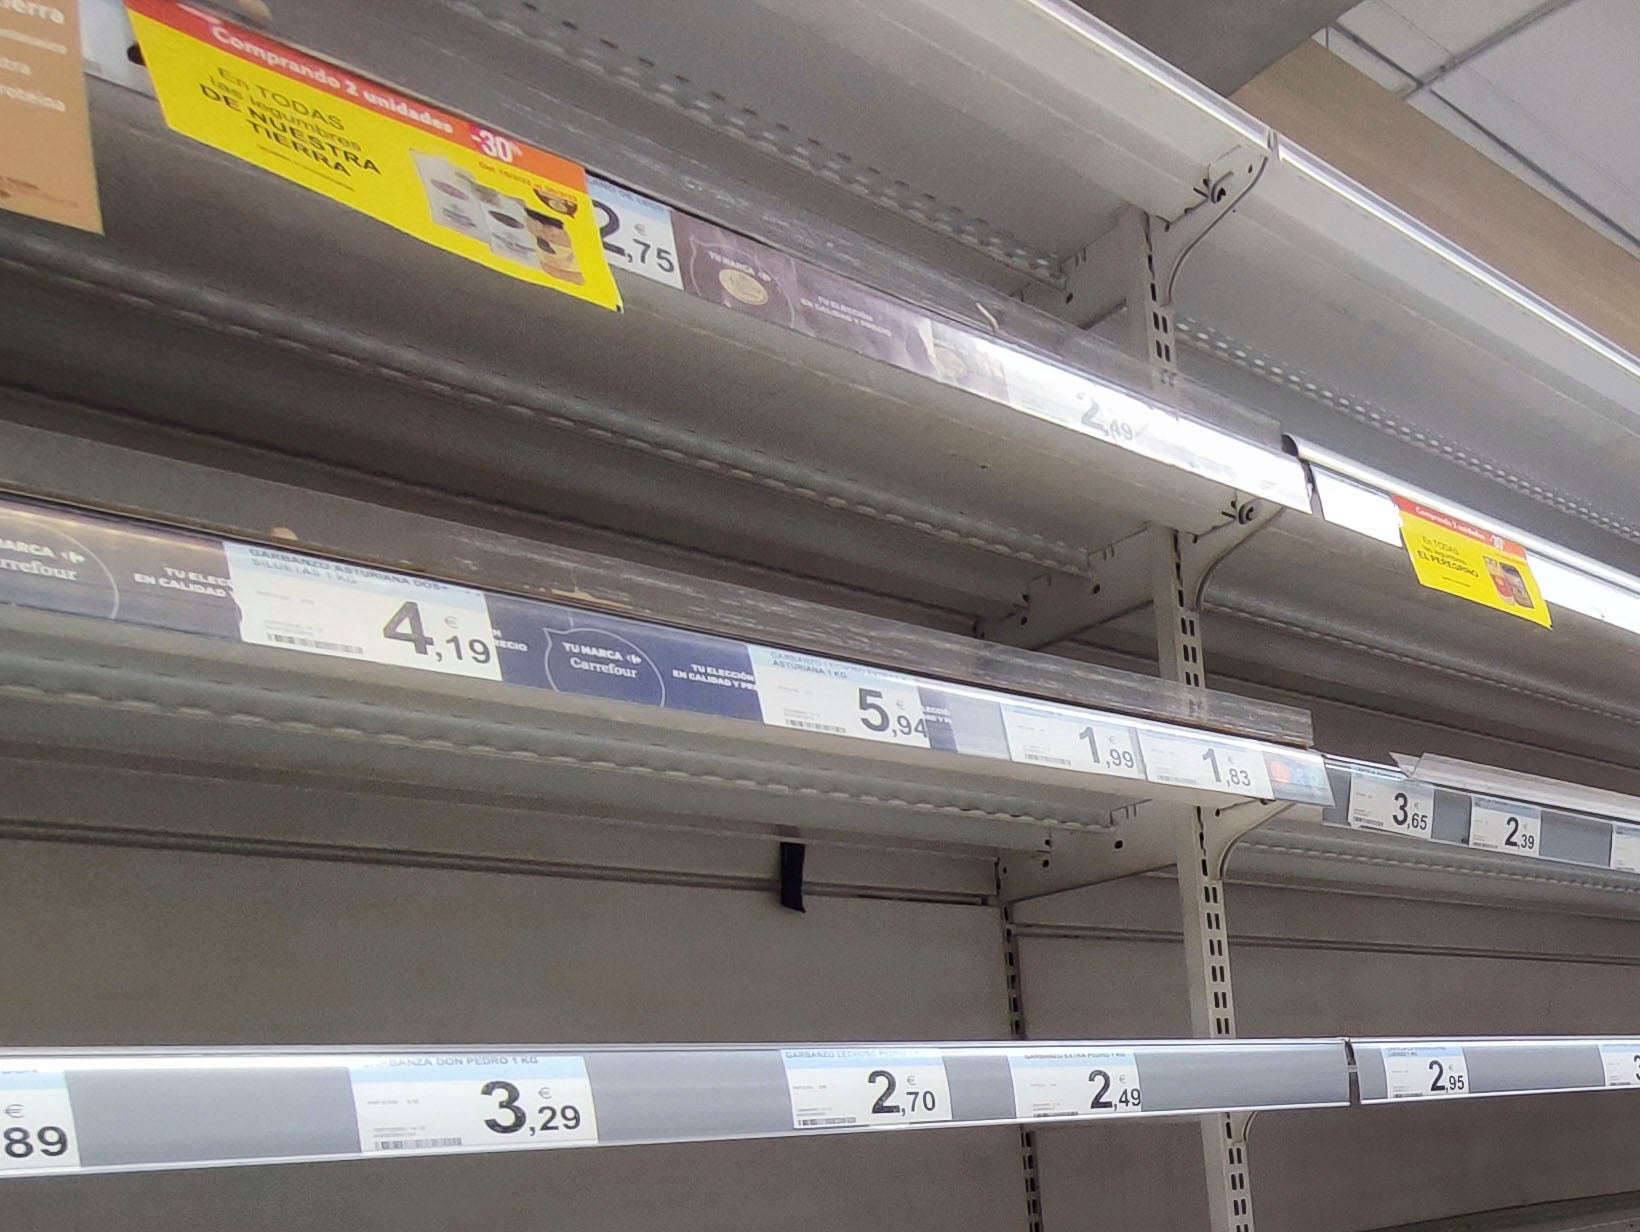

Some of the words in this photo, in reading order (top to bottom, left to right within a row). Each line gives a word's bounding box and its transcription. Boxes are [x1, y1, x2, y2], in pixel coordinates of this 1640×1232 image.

[212, 26, 341, 89] Comprando
[345, 79, 359, 98] 2
[362, 90, 453, 134] unidades
[218, 67, 250, 92] En
[255, 84, 345, 131] TODAS
[199, 83, 243, 113] DE
[247, 106, 382, 176] NUESTRA
[209, 75, 243, 100] las
[250, 96, 362, 152] legumbres
[245, 118, 352, 177] TIERRA
[591, 199, 675, 272] 2,75
[134, 573, 156, 586] EN
[158, 577, 228, 598] CALIDAD
[163, 566, 186, 579] TU
[250, 548, 332, 571] GARBANZO
[335, 564, 411, 586] ASTURIANA
[382, 601, 491, 665] 4,19
[562, 642, 580, 653] TU
[580, 645, 623, 662] MARCA
[570, 657, 638, 679] Carrefour
[672, 669, 687, 680] EN
[688, 671, 731, 687] CALIDAD
[731, 680, 740, 688] Y
[691, 663, 706, 674] TU
[706, 665, 755, 682] ELECCIÓN
[772, 660, 826, 675] ASTURIANA
[858, 688, 928, 738] 5,94
[1078, 726, 1134, 769] 1,99
[1202, 748, 1251, 786] 1,83
[1393, 792, 1428, 830] 3,65
[1504, 816, 1535, 849] 2,39
[435, 1056, 464, 1067] DON
[467, 1055, 508, 1066] PEDRO
[521, 1055, 539, 1065] KG
[1428, 1060, 1465, 1094] 2,95
[480, 1079, 581, 1137] 3,29
[537, 1087, 553, 1100] €
[867, 1069, 936, 1117] 2,70
[1088, 1069, 1141, 1112] 2,49
[4, 1103, 25, 1119] €
